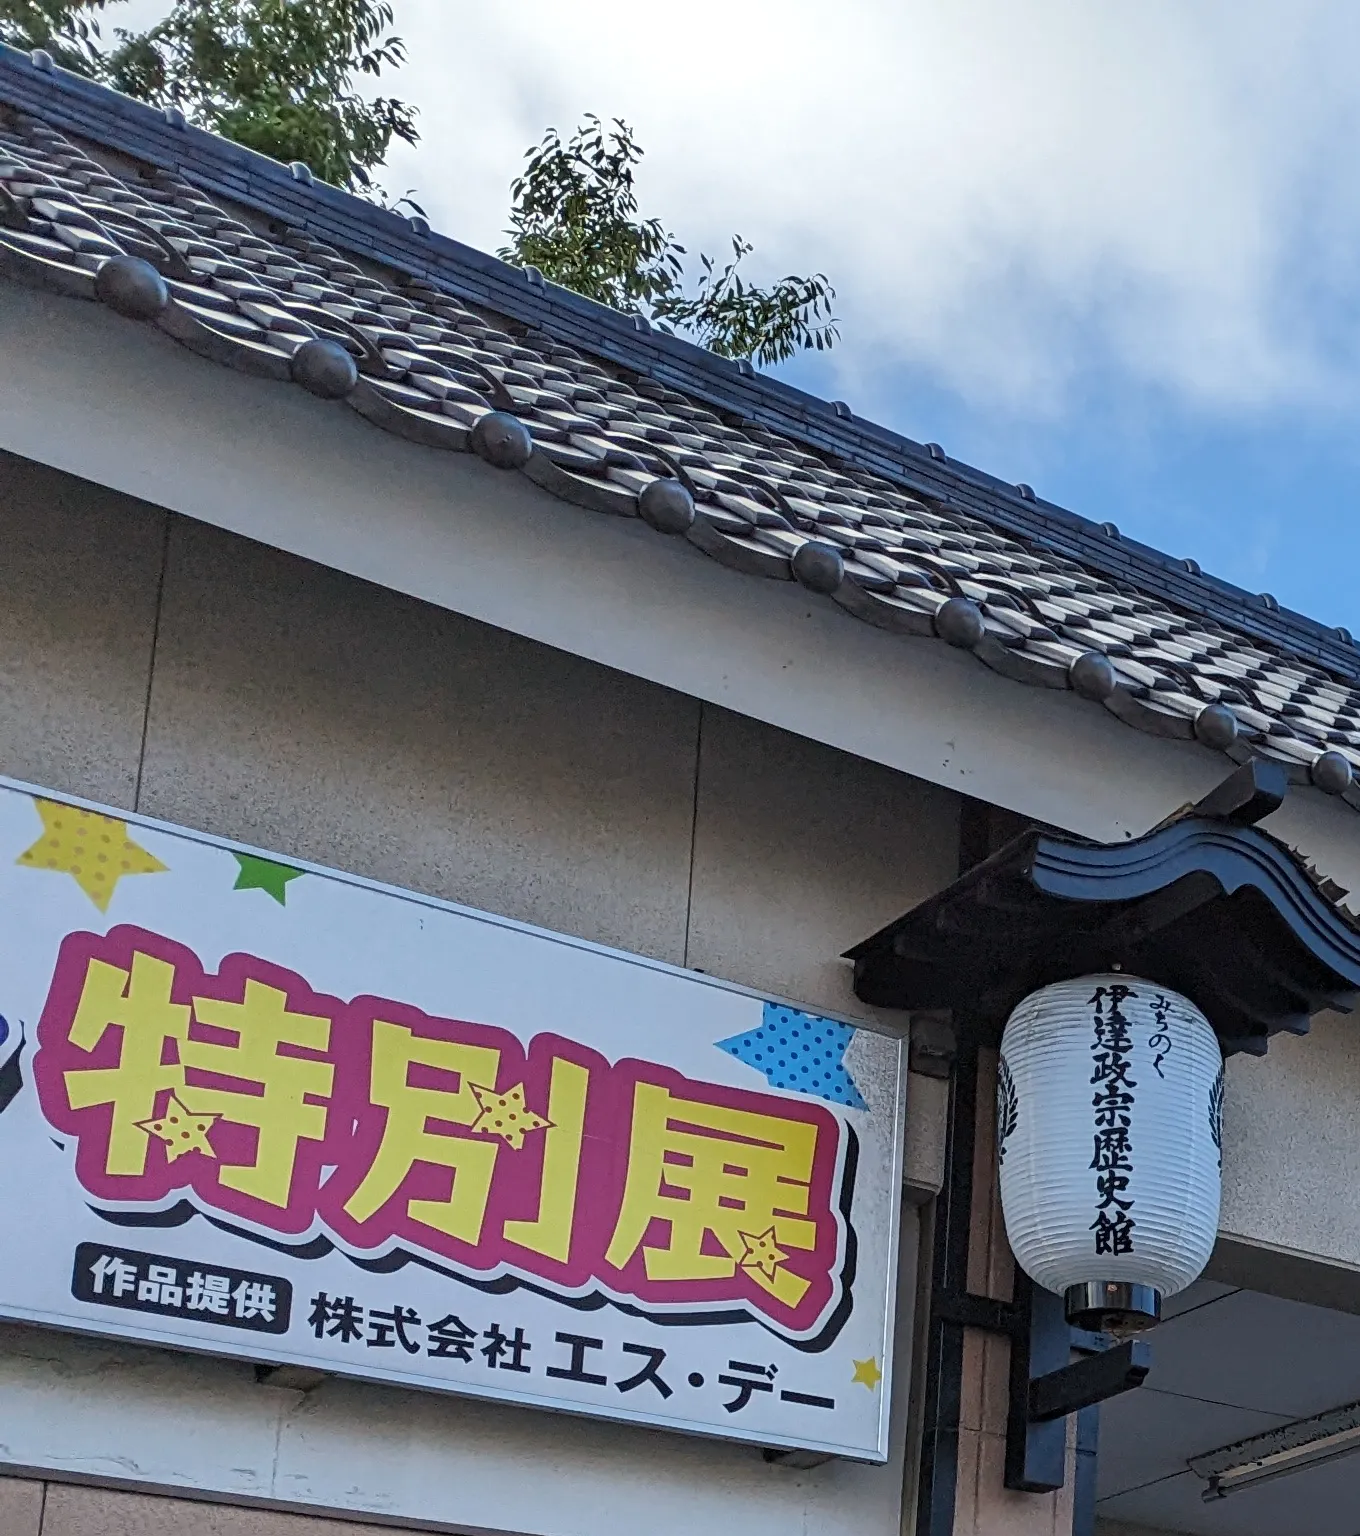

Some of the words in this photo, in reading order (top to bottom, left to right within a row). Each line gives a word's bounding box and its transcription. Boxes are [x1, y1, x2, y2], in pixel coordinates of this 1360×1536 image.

[1087, 985, 1138, 1256] 伊達政宗歴史館
[1148, 994, 1173, 1079] みちのく
[62, 945, 824, 1312] 特別展
[89, 1257, 278, 1323] 作品提供
